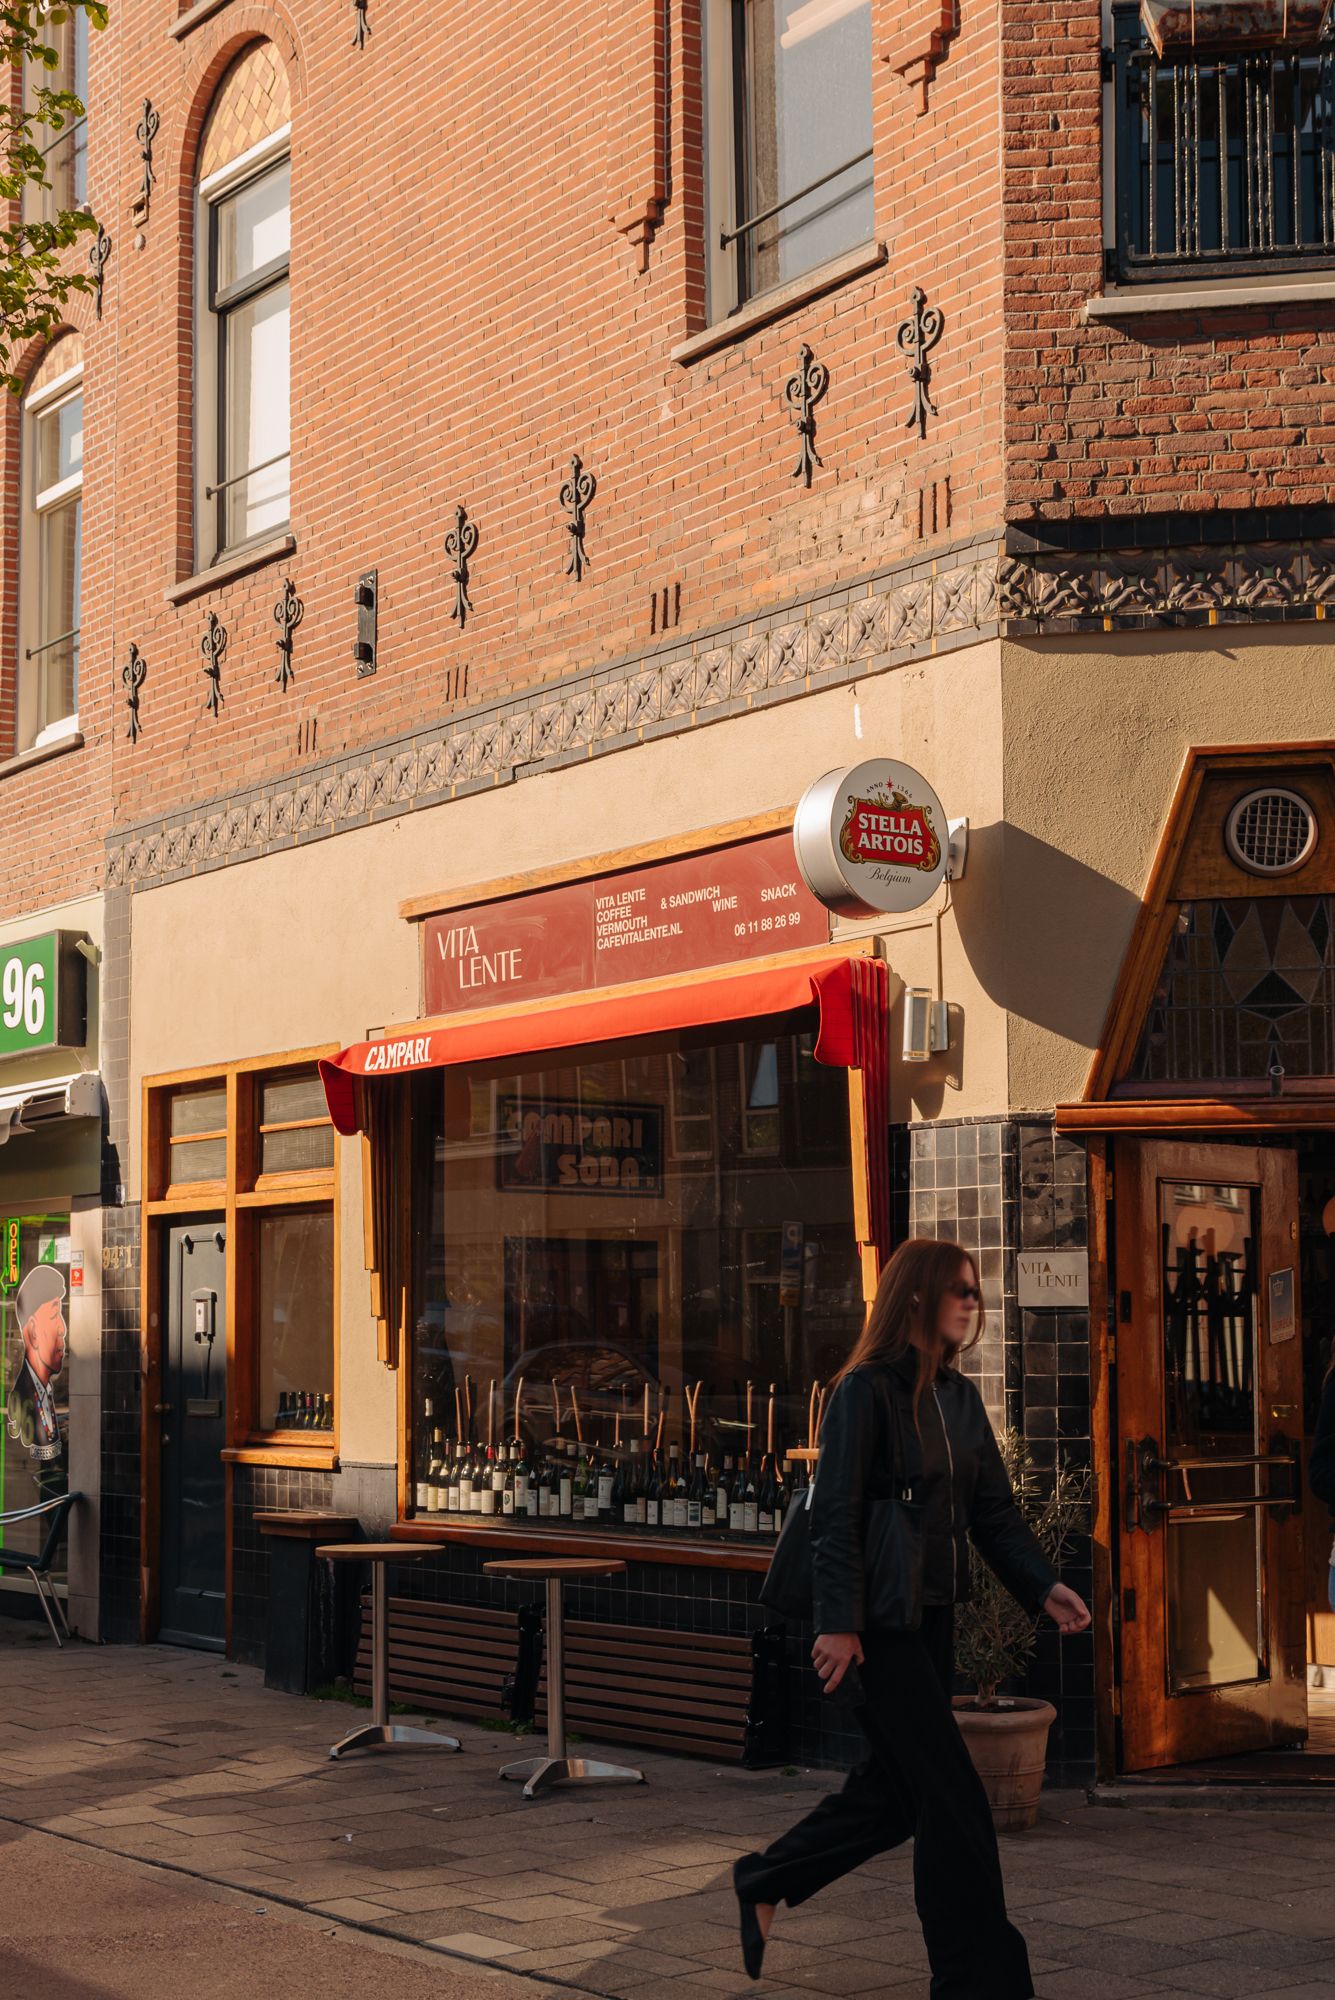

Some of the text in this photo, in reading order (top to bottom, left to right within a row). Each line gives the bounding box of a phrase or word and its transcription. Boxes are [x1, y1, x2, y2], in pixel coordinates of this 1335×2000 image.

[865, 782, 884, 794] ANNO
[858, 813, 923, 836] STELLA
[858, 832, 924, 856] ARTOIS
[868, 867, 912, 887] Belgium
[596, 888, 646, 910] VITA LENTE
[660, 886, 721, 910] & SANDWICH
[712, 896, 738, 913] WINE
[760, 882, 797, 903] SNACK
[596, 905, 632, 924] COFFEE
[596, 916, 648, 937] VERMOUTH
[734, 911, 801, 937] 06 11 88 26 99
[437, 925, 480, 961] VITA
[596, 922, 683, 950] CAFEVITALENTE.NL
[459, 948, 523, 990] LENTE
[2, 957, 45, 1035] 96
[364, 1036, 431, 1072] CAMPARI
[506, 1111, 643, 1149] CAMPARI
[557, 1153, 640, 1188] SODA
[9, 1223, 18, 1282] OPEN
[1021, 1261, 1052, 1275] VITA
[1038, 1274, 1083, 1288] LENTE
[8, 1390, 36, 1448] 96
